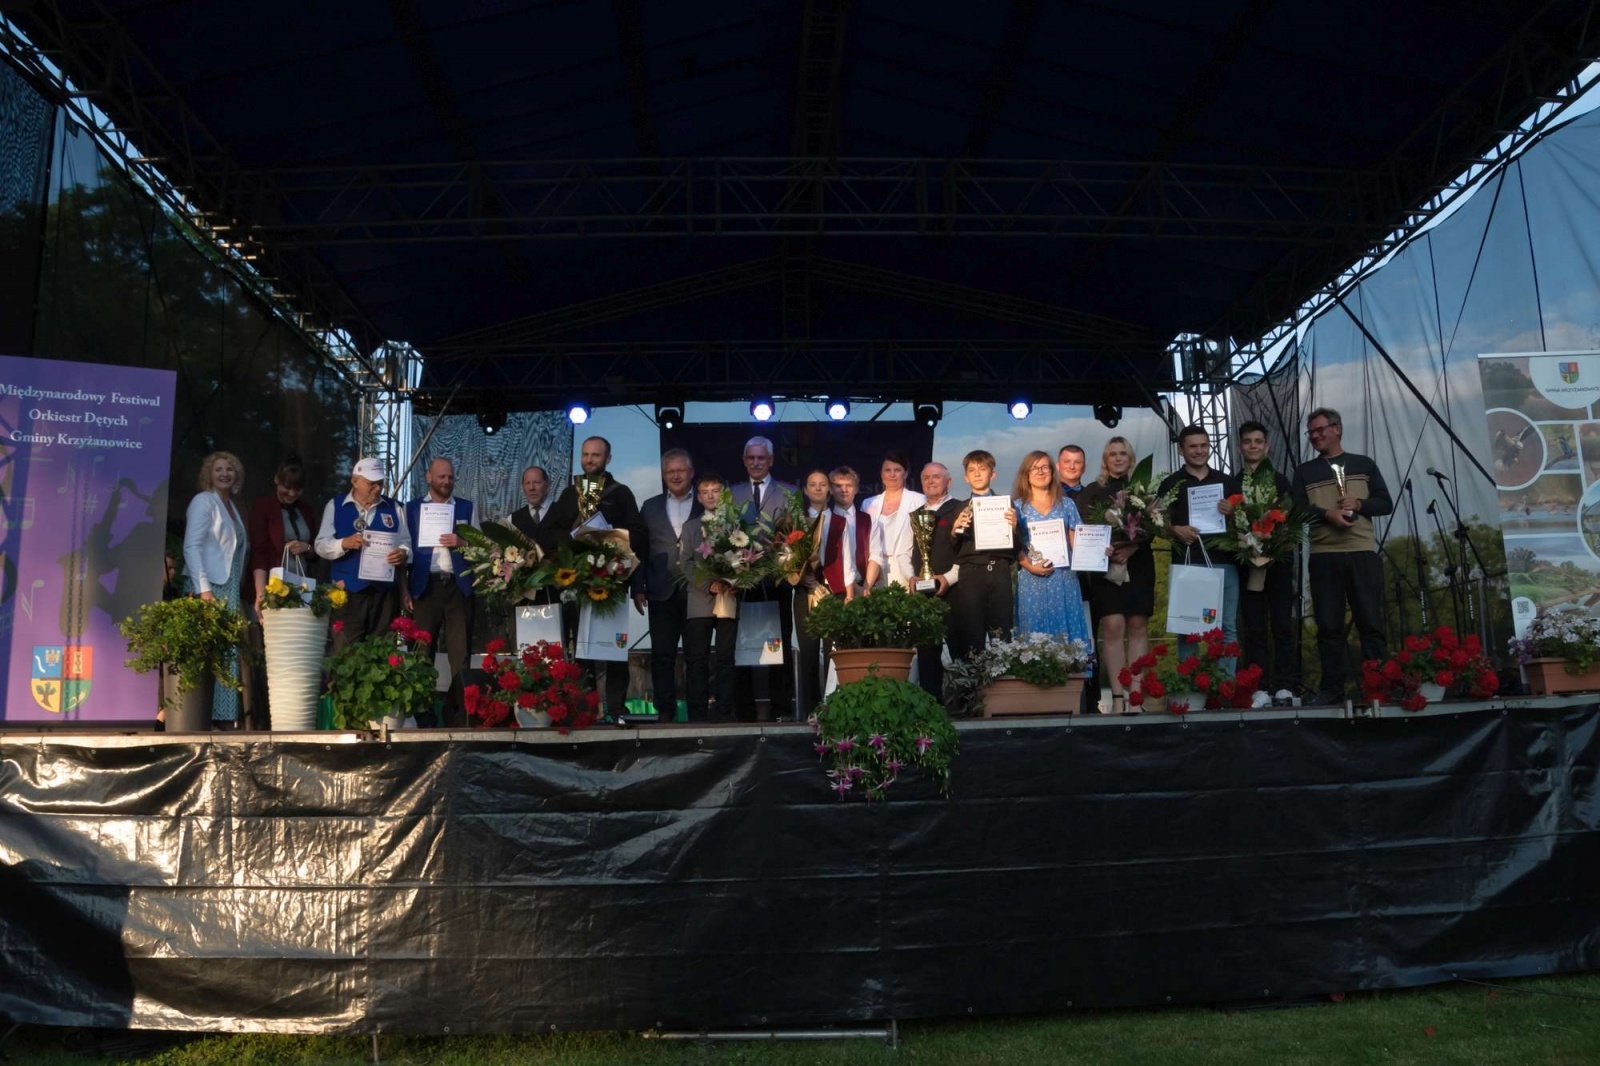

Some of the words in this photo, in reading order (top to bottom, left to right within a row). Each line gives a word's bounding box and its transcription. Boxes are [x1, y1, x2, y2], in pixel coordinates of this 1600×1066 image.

[0, 384, 106, 405] Międzynarodowy
[111, 392, 161, 407] Festiwal
[28, 408, 82, 423] Orkiestr
[84, 412, 128, 428] Dętych
[10, 430, 55, 446] Gminy
[57, 433, 143, 449] Krzyżanowice
